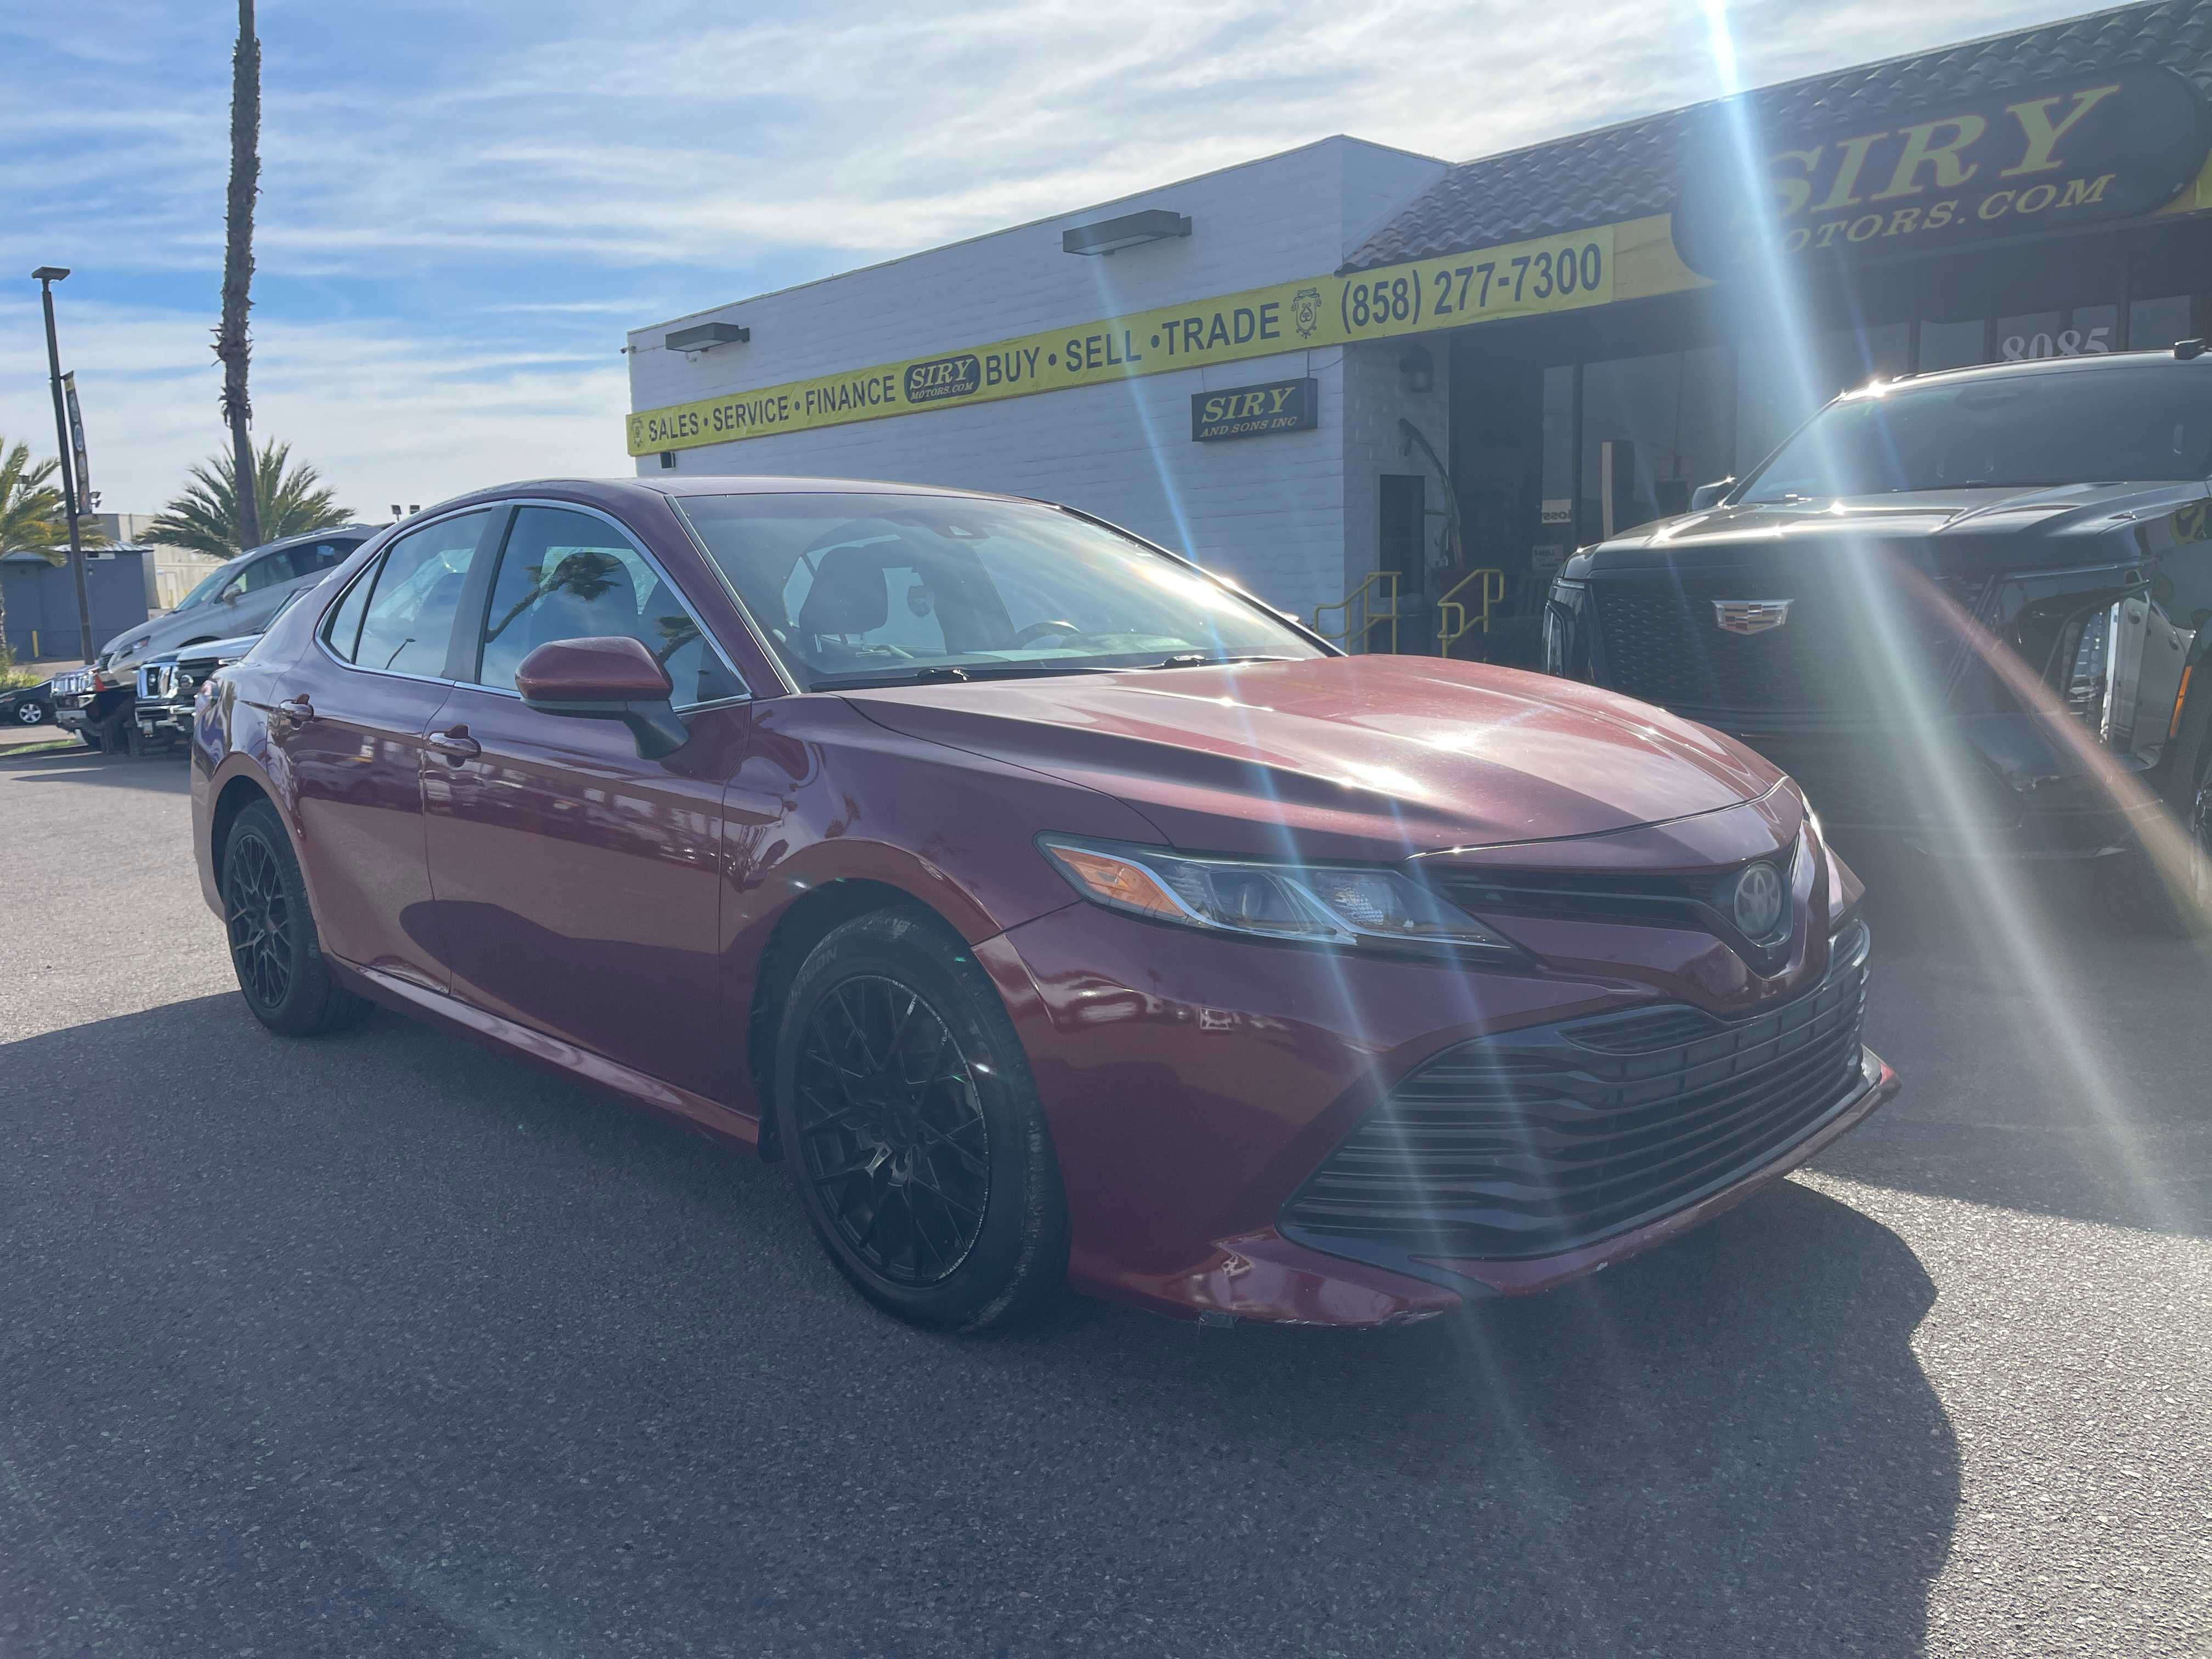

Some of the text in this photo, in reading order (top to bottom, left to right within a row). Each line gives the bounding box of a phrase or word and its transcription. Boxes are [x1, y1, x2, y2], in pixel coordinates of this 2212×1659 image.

[1731, 83, 2121, 228] SIRY
[1734, 173, 2116, 266] OTORS.COM
[1341, 242, 1602, 335] (858) 277-7300
[986, 302, 1281, 386] BUY SELL TRADE
[2001, 325, 2111, 362] 8085
[908, 358, 975, 391] SIRY
[910, 382, 974, 401] MOTORS.COM
[648, 375, 895, 442] SALES SERVICE FINANCE
[1199, 416, 1297, 438] AND SONS INC
[1201, 386, 1296, 424] SIRY
